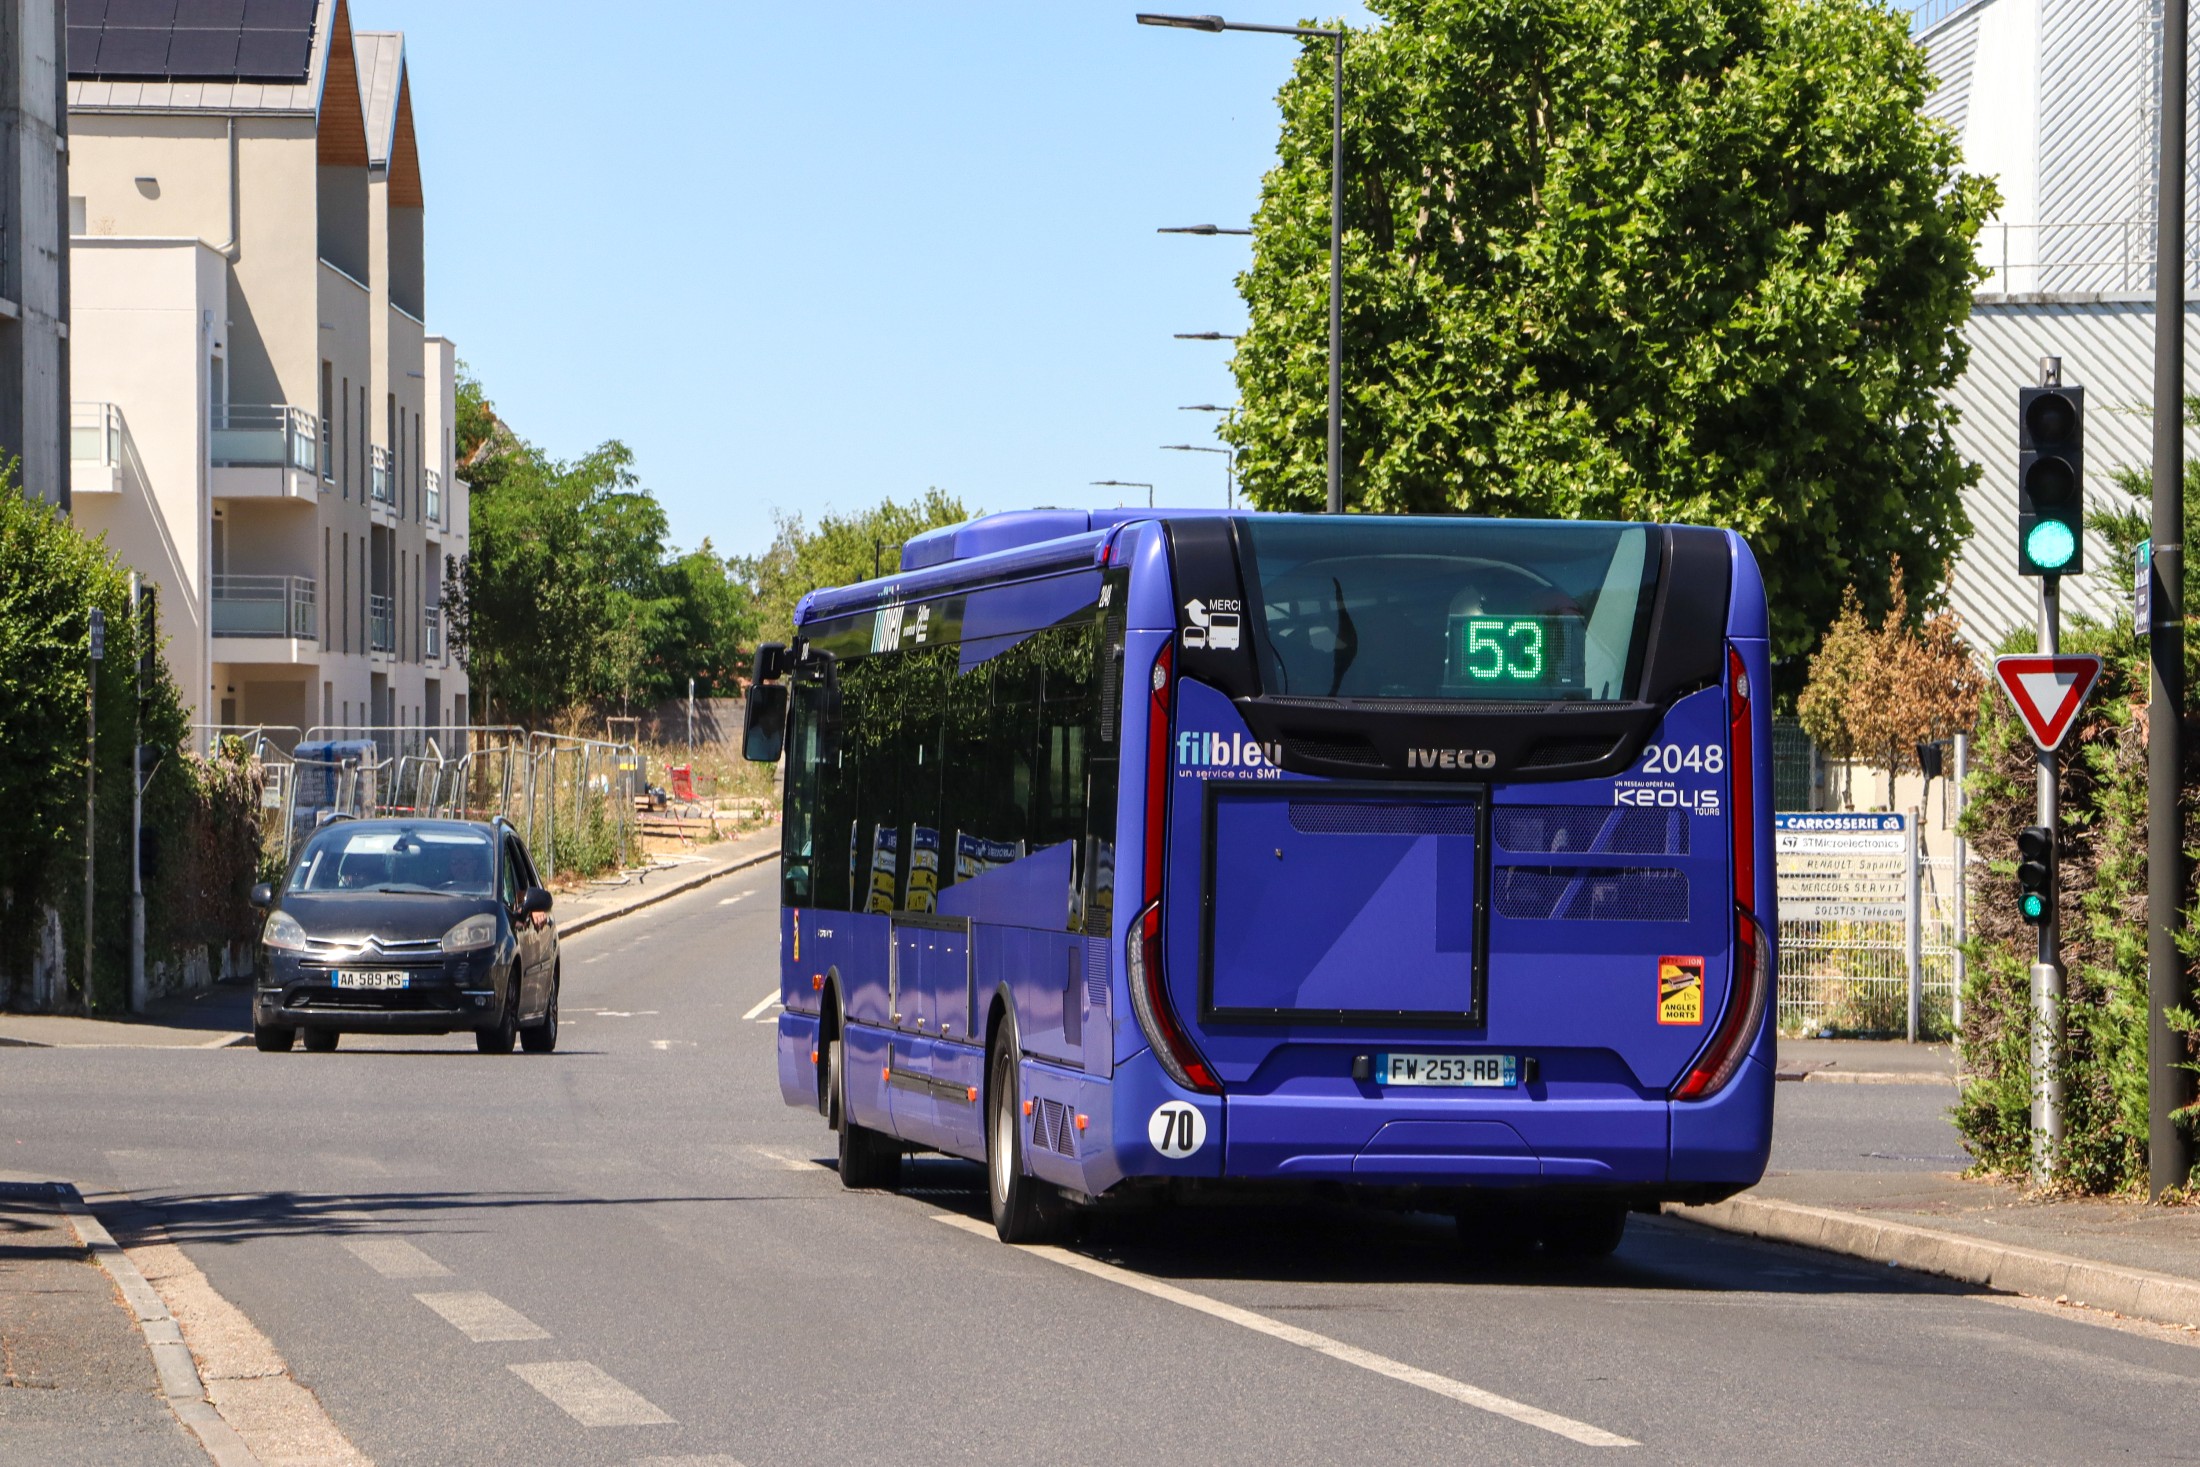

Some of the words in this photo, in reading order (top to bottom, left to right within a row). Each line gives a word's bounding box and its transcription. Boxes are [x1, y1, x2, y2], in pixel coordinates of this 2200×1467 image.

[1209, 599, 1241, 611] MERCI
[1469, 621, 1542, 678] 53
[1176, 731, 1282, 767] filbleu
[1407, 748, 1497, 769] IVECO
[1642, 743, 1724, 774] 2048
[1179, 770, 1192, 778] un
[1196, 769, 1235, 778] service
[1239, 770, 1253, 779] du
[1256, 768, 1283, 779] SMT
[1694, 807, 1720, 816] TOURS
[1787, 818, 1879, 830] CARROSSERIE
[1802, 837, 1899, 849] STMicroelectronics
[1806, 860, 1852, 869] RENAULT
[1800, 882, 1850, 893] MERCEDES
[1660, 958, 1702, 966] ATTEION
[340, 973, 401, 986] AA-589-MS
[1665, 1003, 1697, 1011] ANGLES
[1666, 1011, 1695, 1019] MORTS
[1392, 1058, 1499, 1081] FW-253-RB
[1504, 1071, 1516, 1083] 37
[1160, 1110, 1194, 1152] 70
